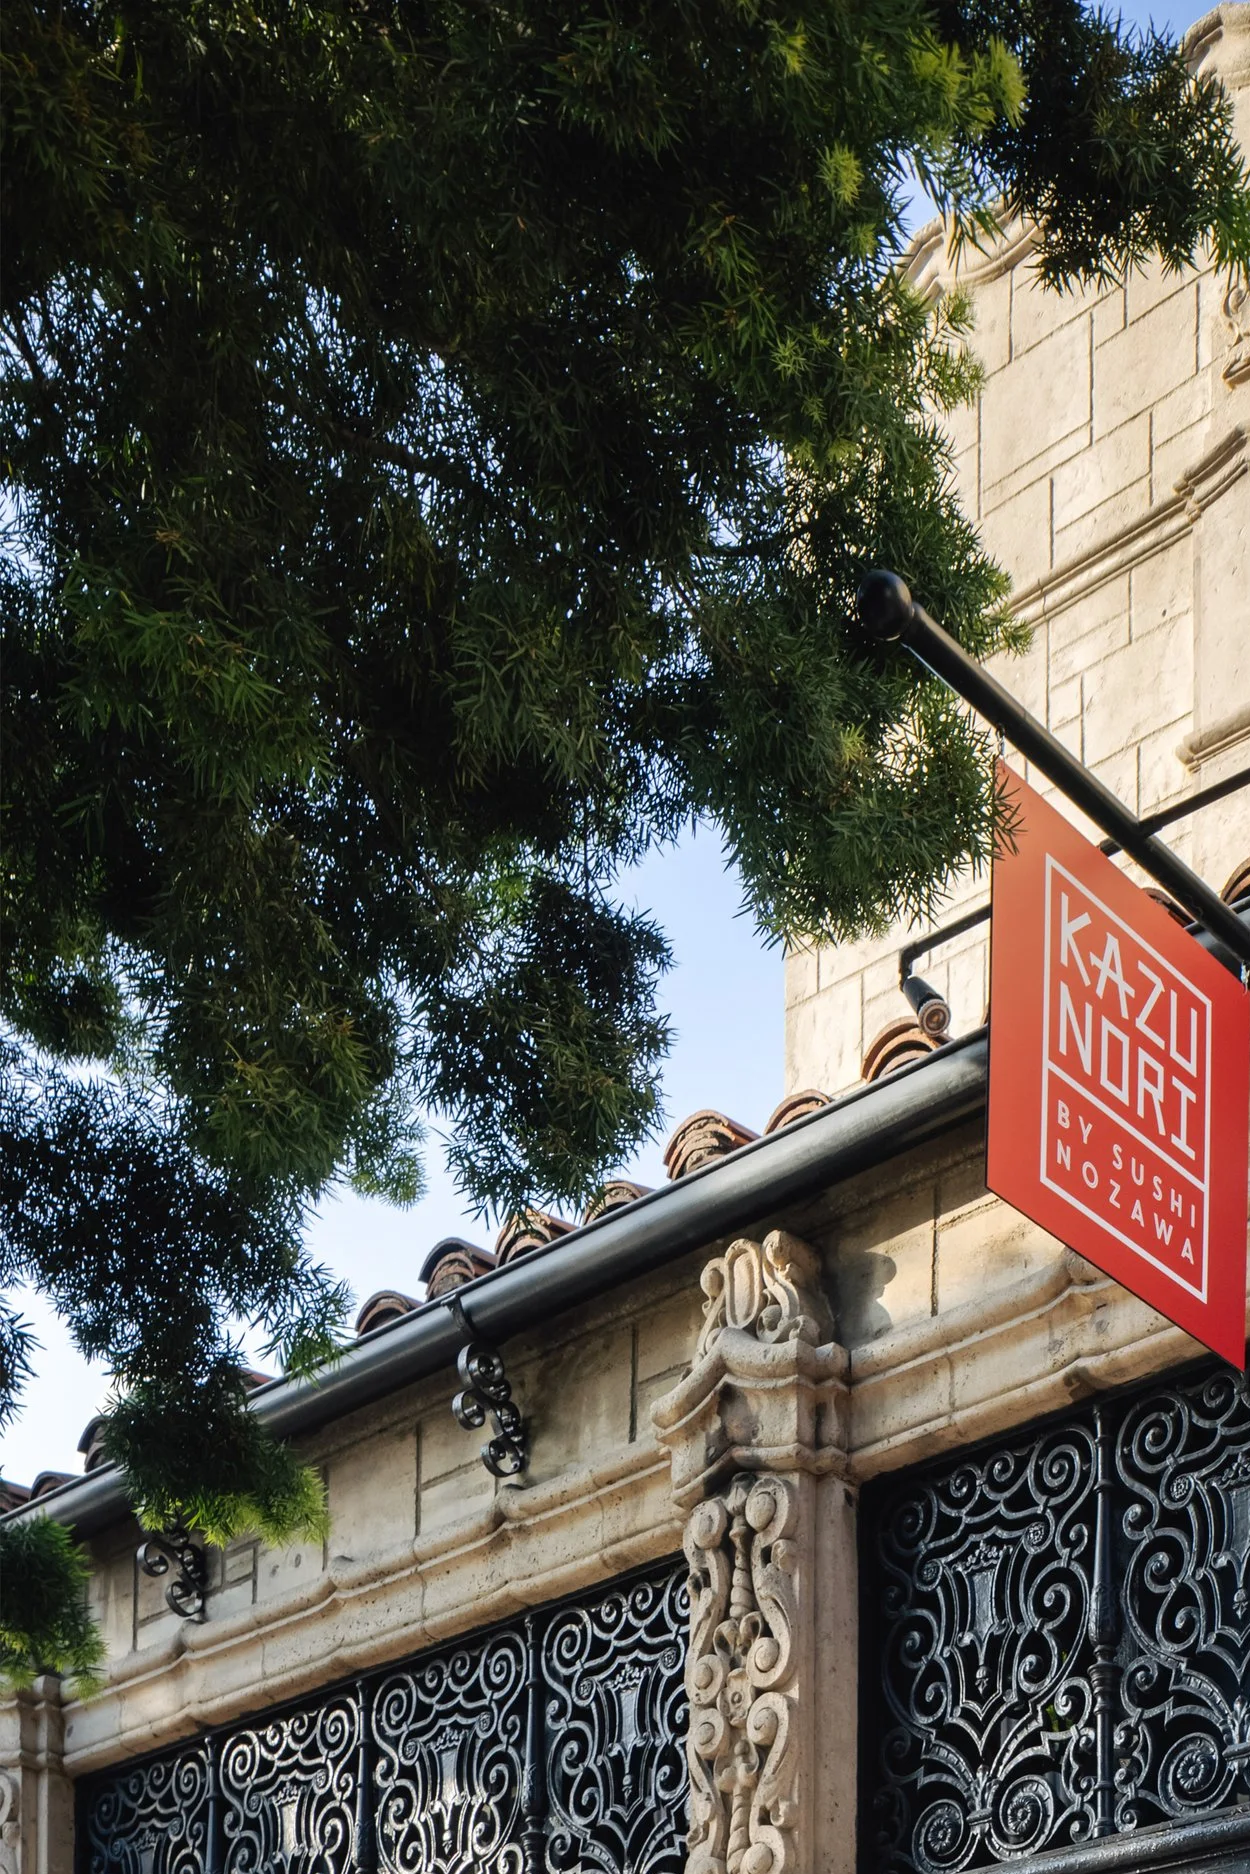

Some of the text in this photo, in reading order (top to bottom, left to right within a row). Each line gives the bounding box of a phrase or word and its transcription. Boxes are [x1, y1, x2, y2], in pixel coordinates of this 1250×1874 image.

[1060, 891, 1198, 1080] KAZU
[1058, 980, 1197, 1161] NORI
[1055, 1137, 1196, 1266] NOZAWA
[1056, 1099, 1197, 1229] BY SUSHI
